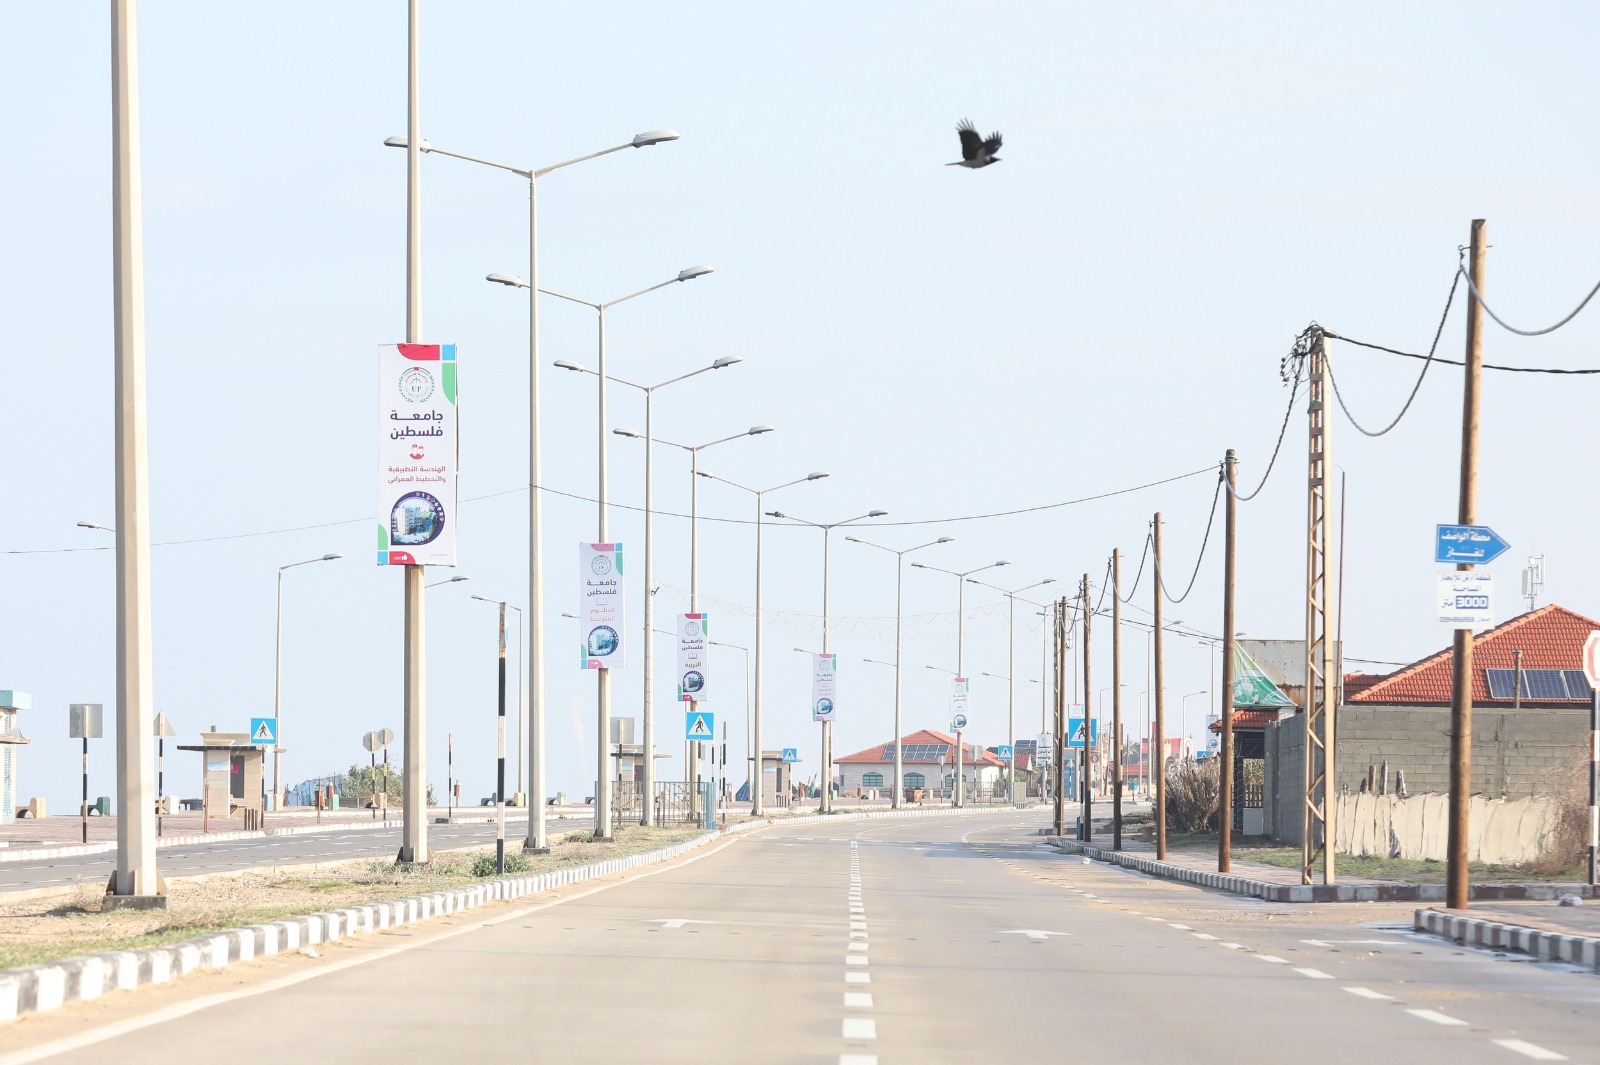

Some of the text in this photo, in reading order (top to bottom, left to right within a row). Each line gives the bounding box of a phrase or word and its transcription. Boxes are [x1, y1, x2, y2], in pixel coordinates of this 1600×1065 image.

[411, 385, 422, 393] UP
[390, 409, 444, 424] جامعة
[390, 425, 444, 440] فلسطين
[388, 465, 446, 474] الهندسة التطبيقية
[415, 475, 447, 484] والتخطيط
[1470, 531, 1491, 542] محطة
[586, 578, 617, 588] جامعة
[586, 588, 617, 597] فلسطين
[1456, 596, 1488, 608] 3000
